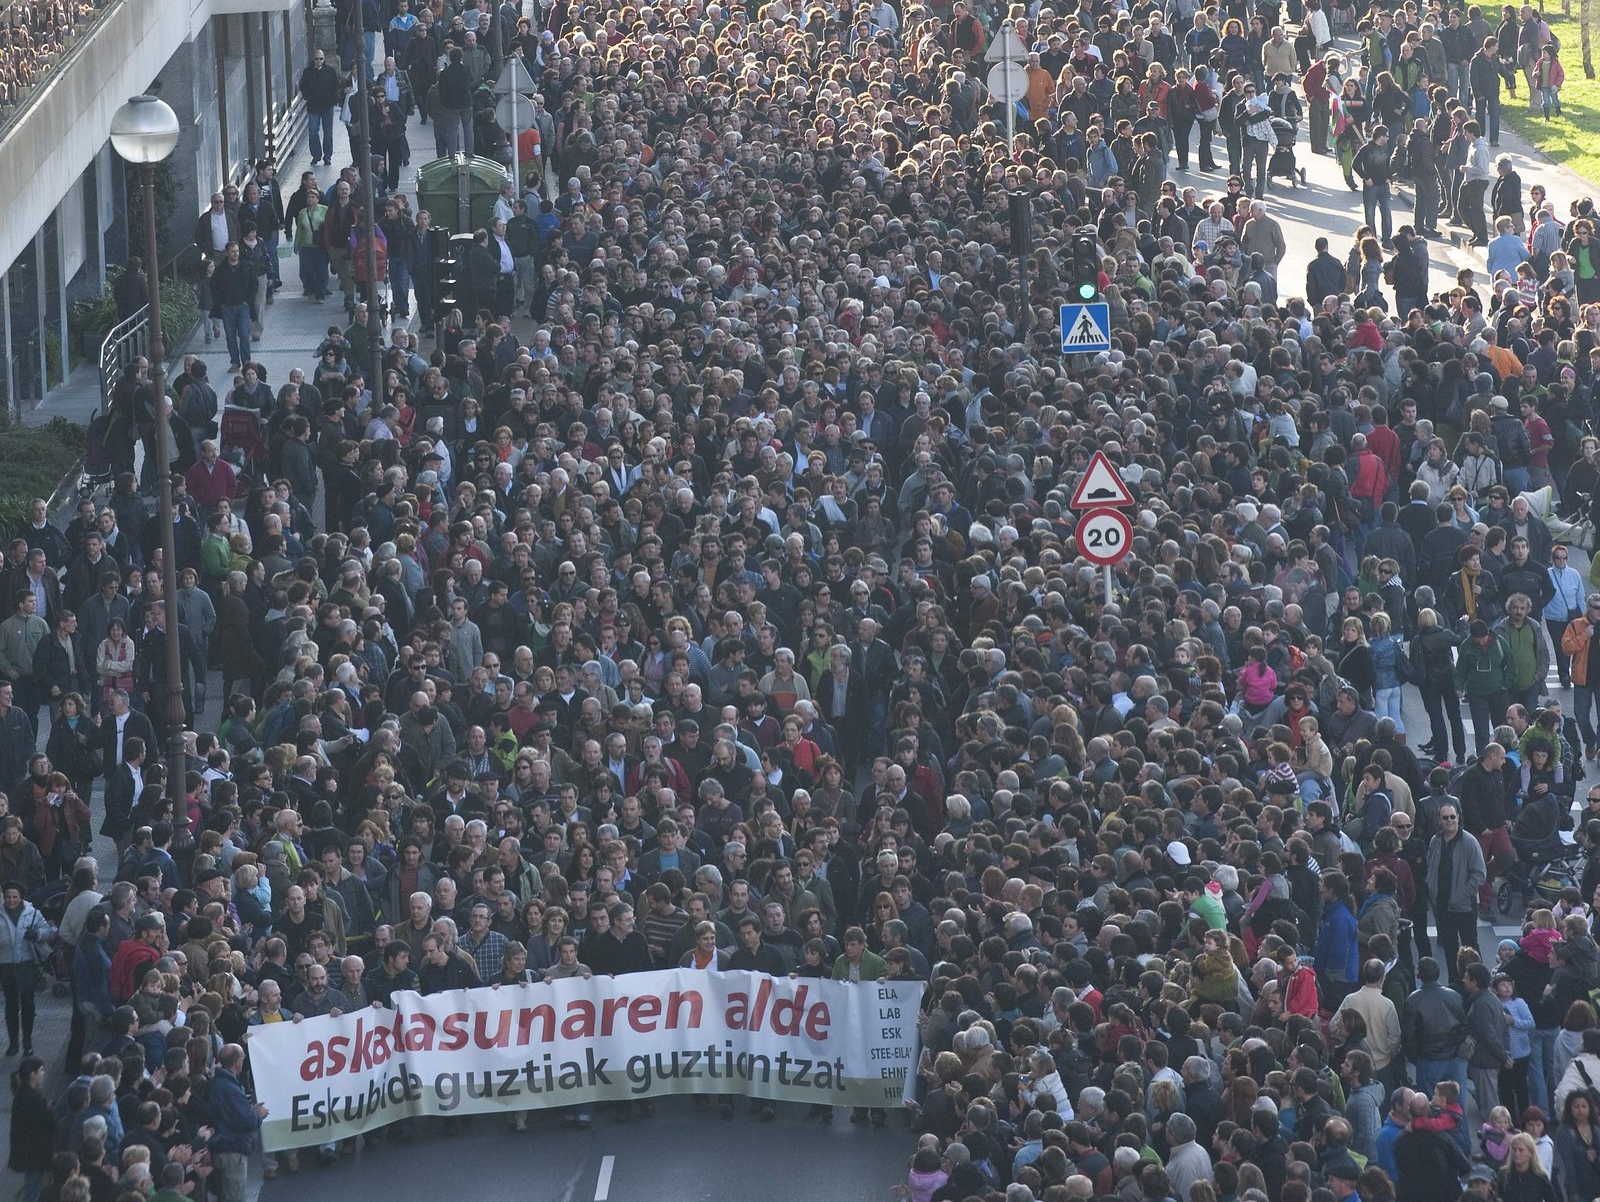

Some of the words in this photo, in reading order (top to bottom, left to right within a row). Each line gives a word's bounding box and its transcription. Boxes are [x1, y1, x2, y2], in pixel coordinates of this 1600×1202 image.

[1088, 528, 1120, 547] 20
[878, 988, 898, 1000] ELA
[880, 1007, 901, 1019] LAB
[300, 989, 703, 1081] askatasunaren
[725, 979, 831, 1041] alde
[882, 1027, 902, 1039] ESK
[291, 1063, 423, 1132] Eskubide
[434, 1047, 611, 1111] guztiak
[626, 1040, 846, 1094] guztiontzat
[884, 1087, 904, 1099] HIR
